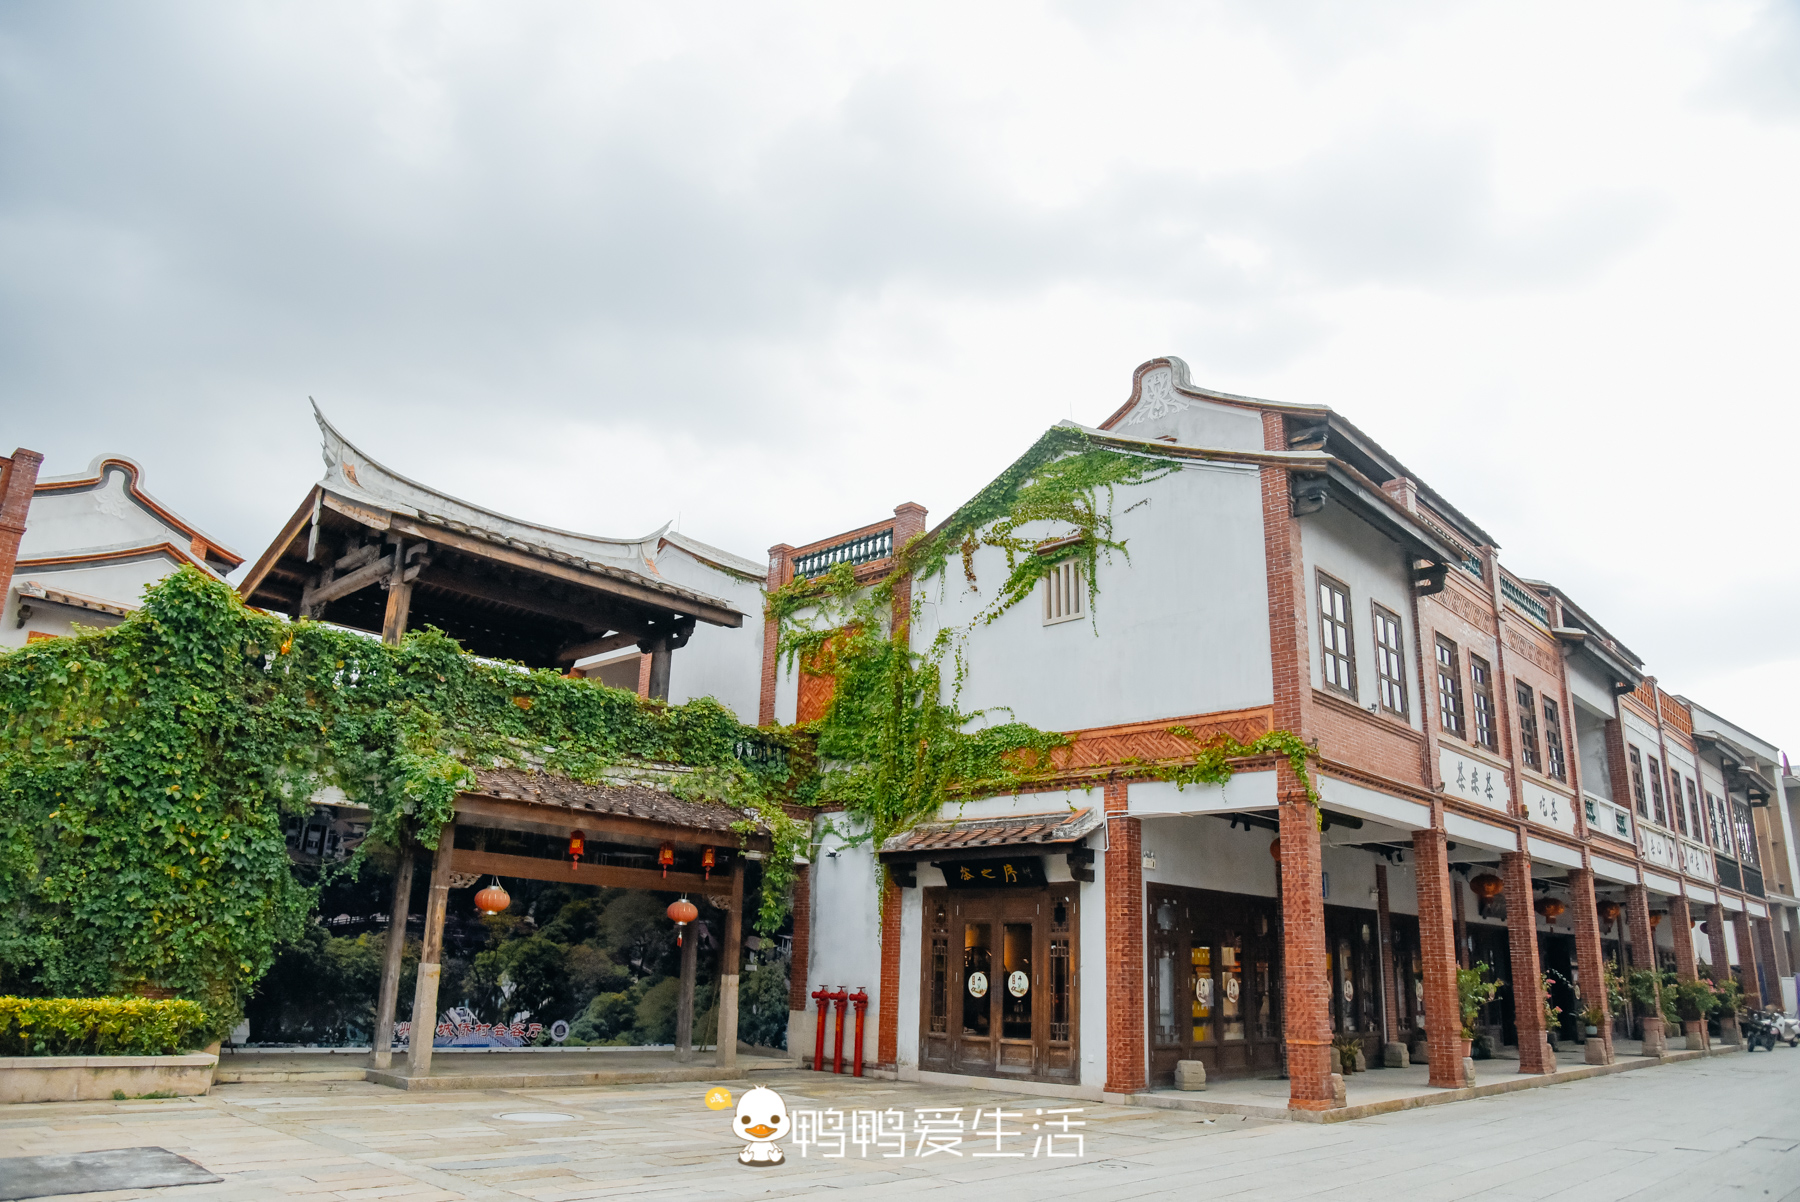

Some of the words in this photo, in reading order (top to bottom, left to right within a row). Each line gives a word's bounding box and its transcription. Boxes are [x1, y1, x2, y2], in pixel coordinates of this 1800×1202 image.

[392, 1021, 543, 1039] 州城侨村会客厅
